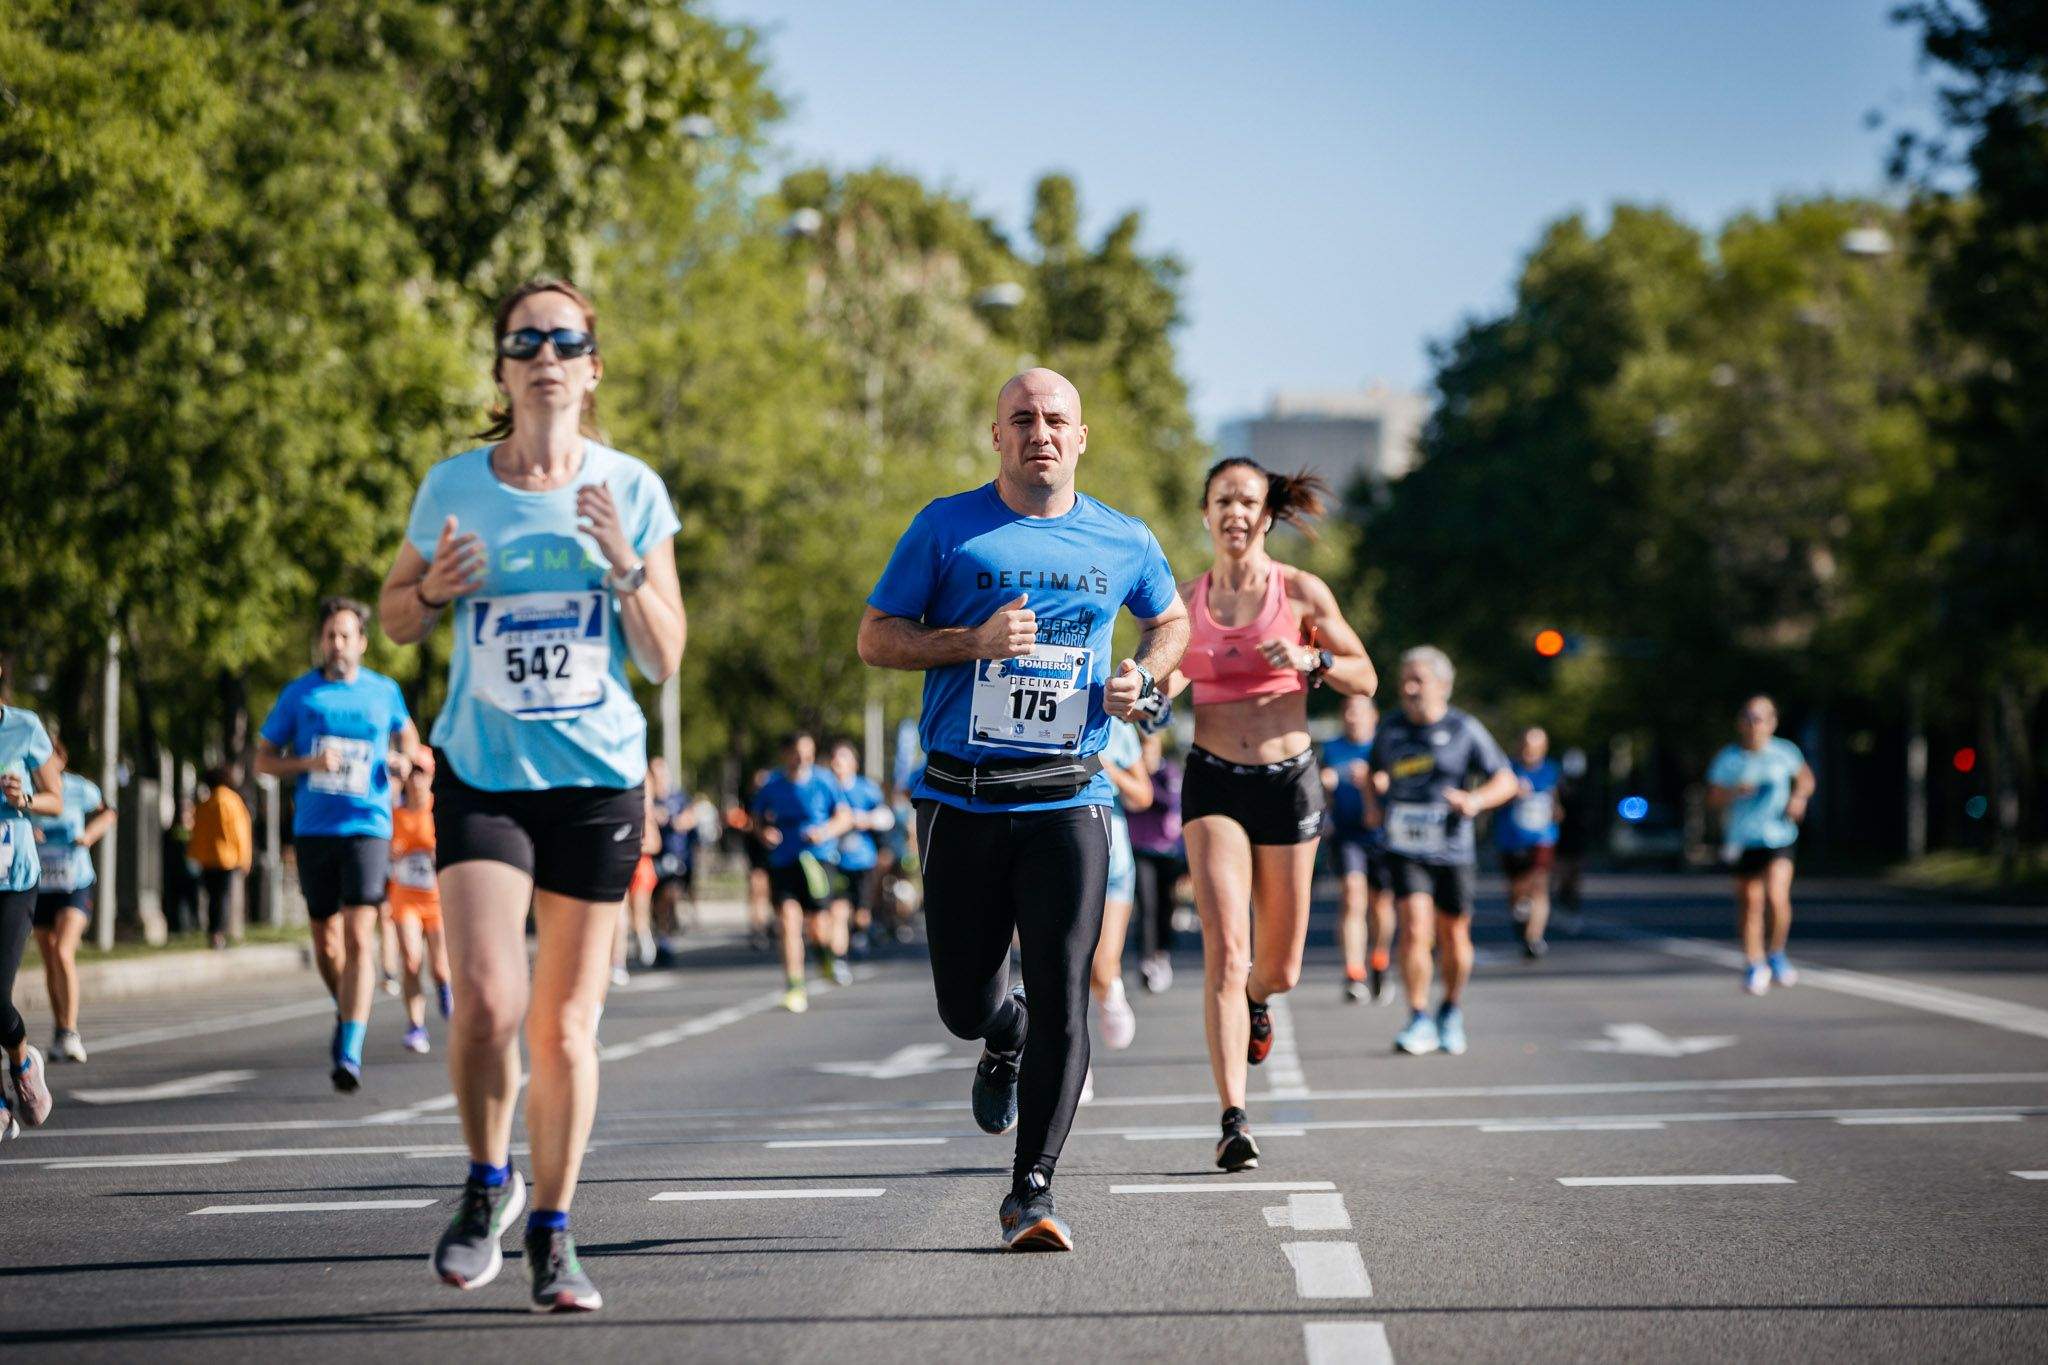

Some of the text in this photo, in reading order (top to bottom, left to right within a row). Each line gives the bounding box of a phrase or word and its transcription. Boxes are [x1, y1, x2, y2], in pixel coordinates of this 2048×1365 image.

[977, 570, 1107, 595] DECIMAS
[1036, 630, 1048, 643] de
[506, 645, 570, 683] 542
[1018, 660, 1072, 671] BOMBEROS
[1009, 677, 1070, 689] DECIMAS
[1010, 689, 1057, 722] 175
